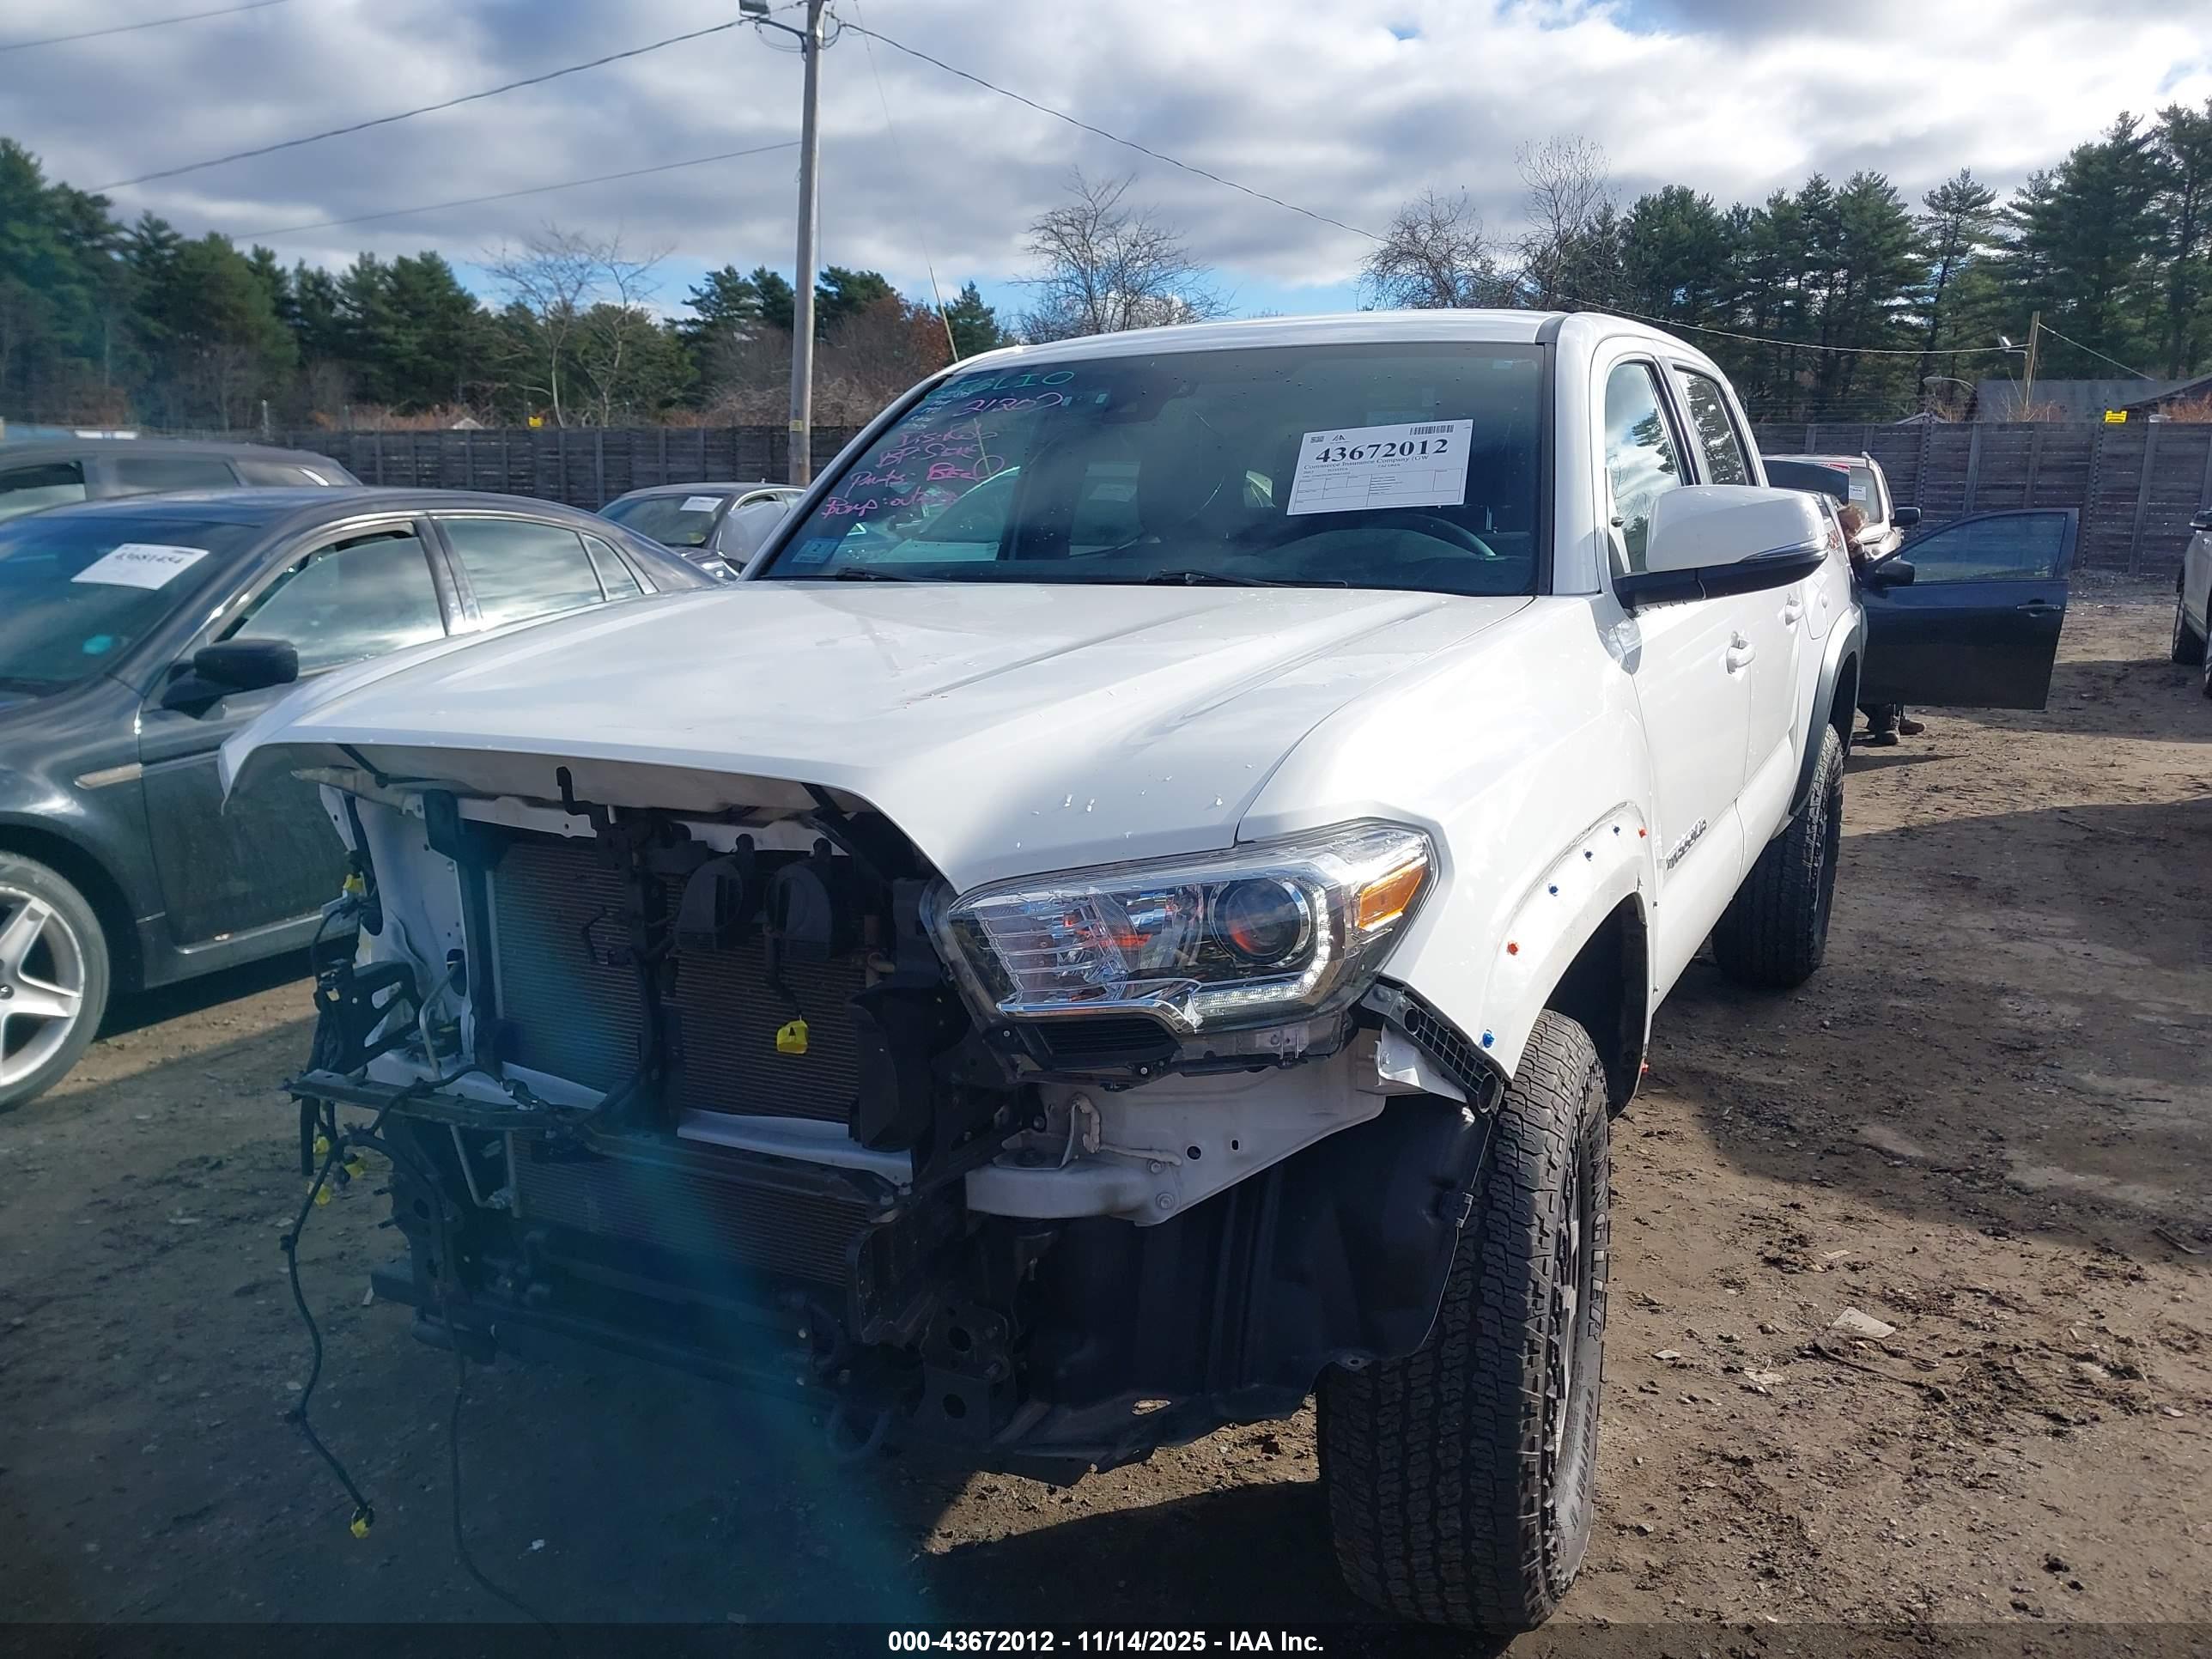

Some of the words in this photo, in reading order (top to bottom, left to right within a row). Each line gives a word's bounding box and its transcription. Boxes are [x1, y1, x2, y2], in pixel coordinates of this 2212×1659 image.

[1315, 438, 1449, 463] 43672012
[1304, 461, 1340, 471] Commerce
[1342, 459, 1375, 467] Insurance
[1376, 455, 1410, 465] Company
